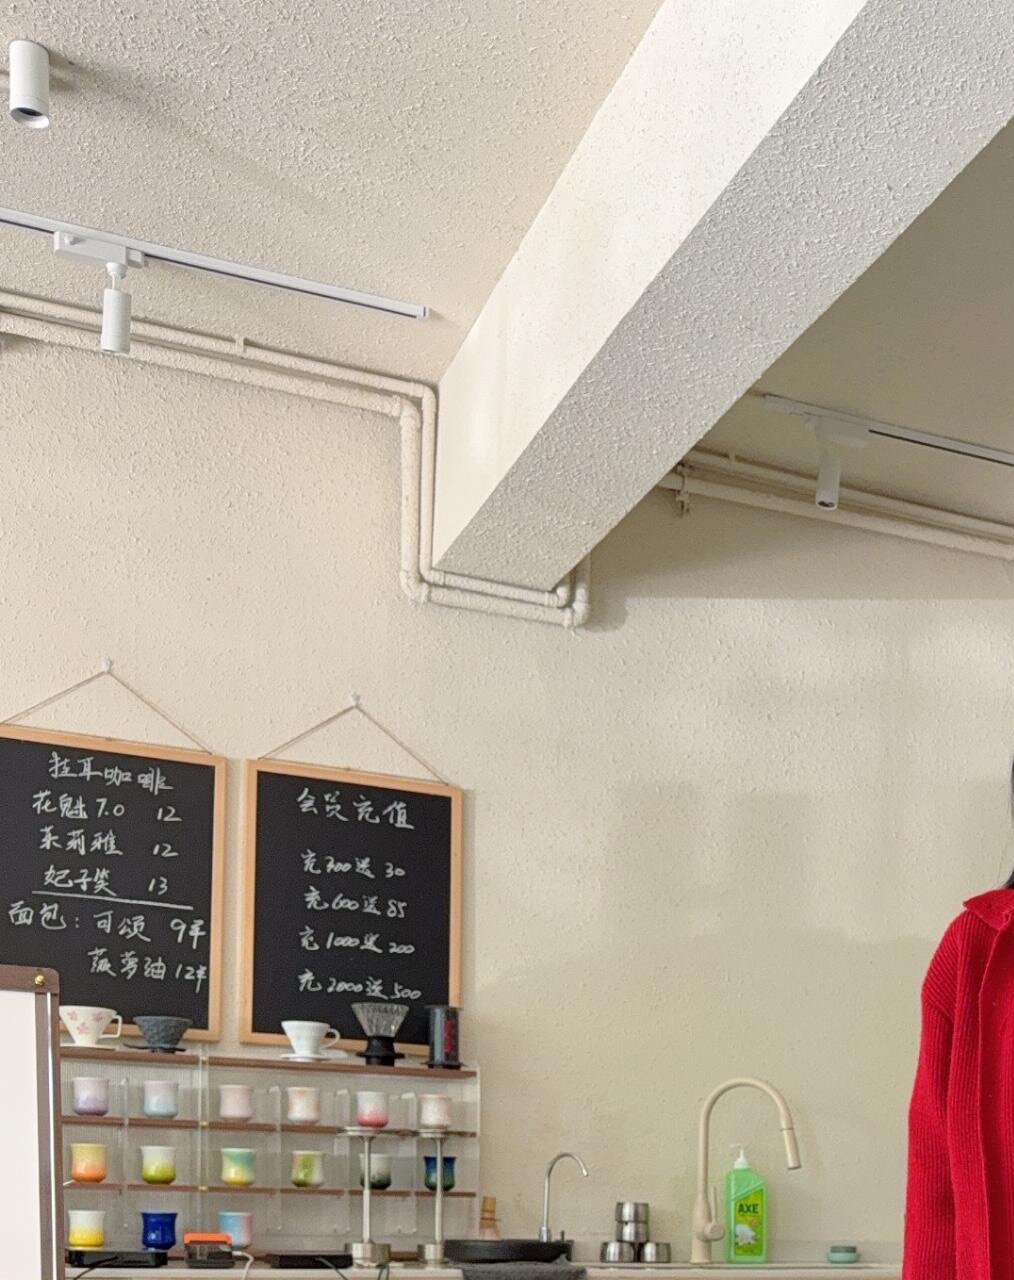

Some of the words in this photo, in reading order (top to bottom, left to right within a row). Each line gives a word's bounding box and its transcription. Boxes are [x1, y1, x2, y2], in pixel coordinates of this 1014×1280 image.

[296, 787, 415, 830] 会员充值
[738, 1203, 759, 1213] AXE
